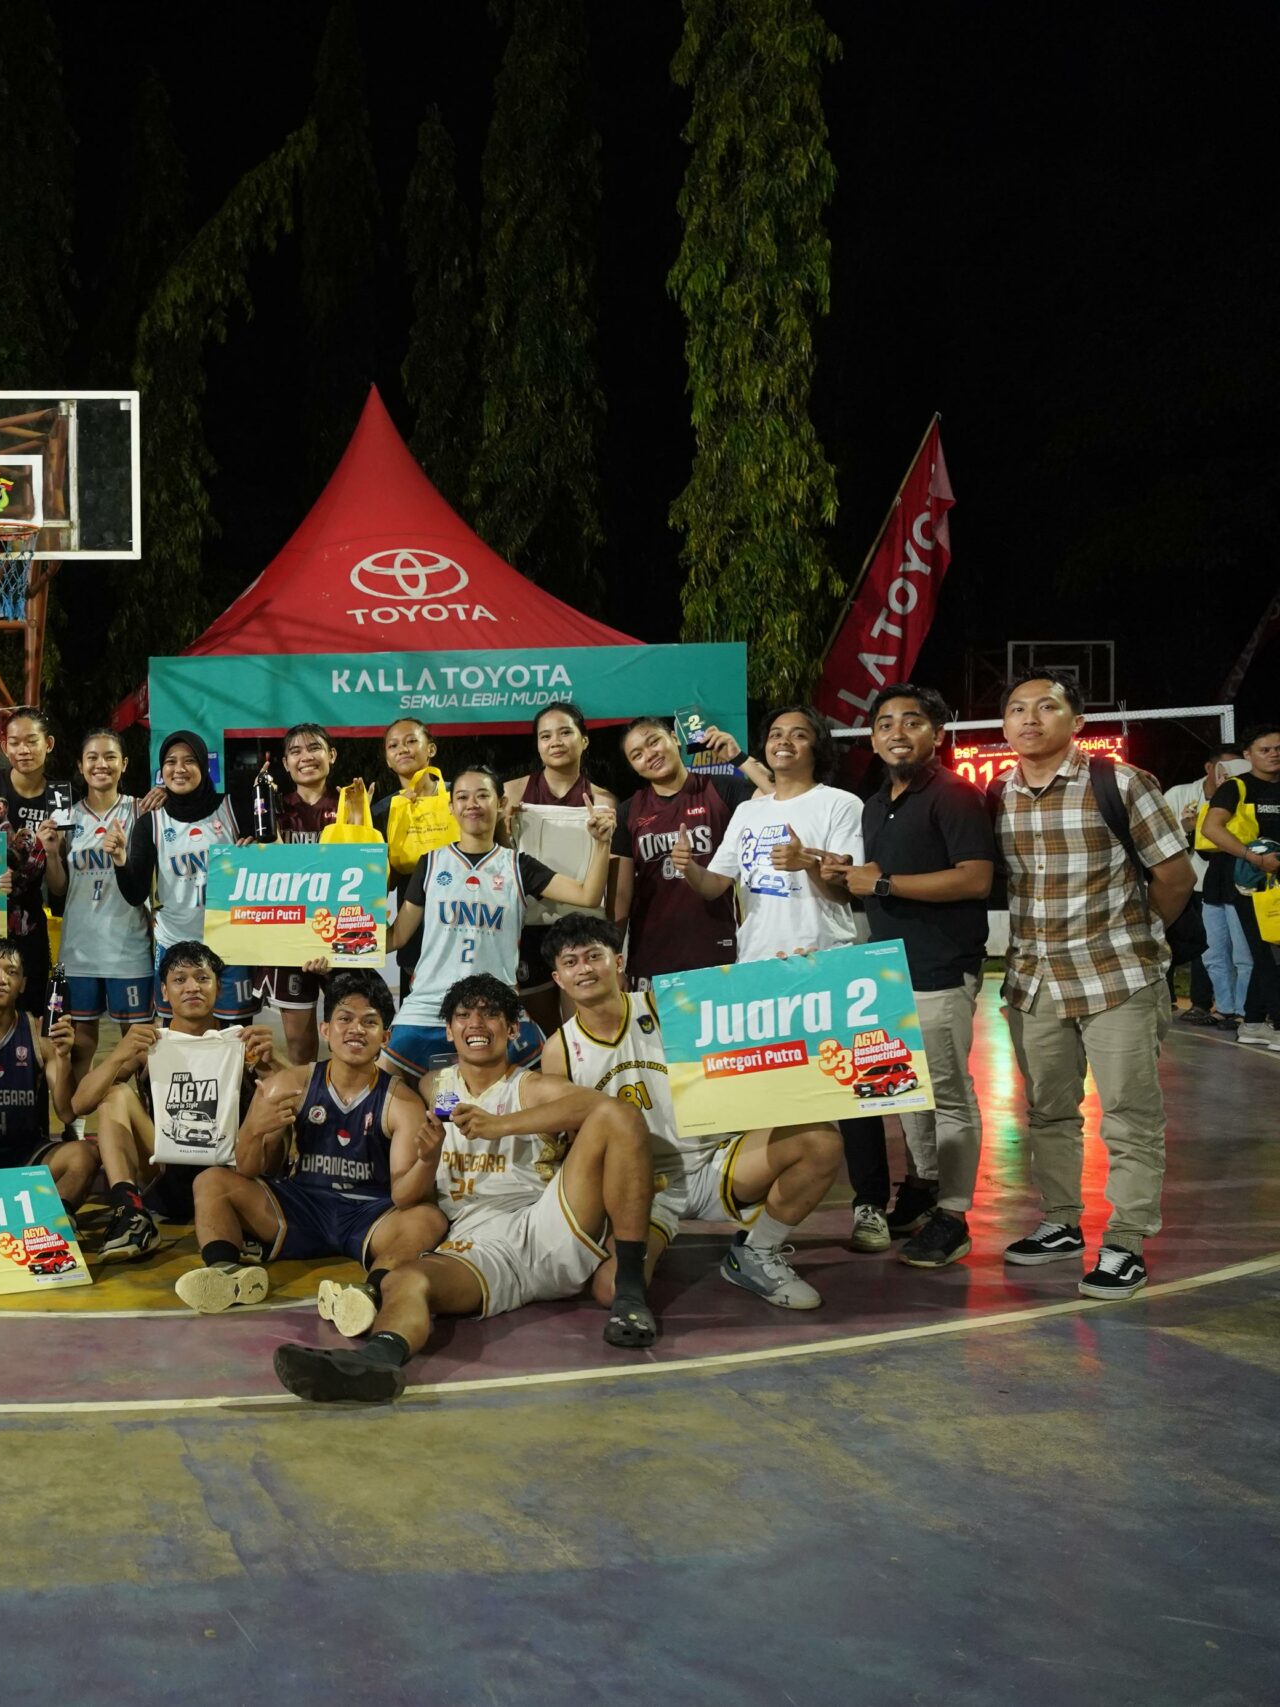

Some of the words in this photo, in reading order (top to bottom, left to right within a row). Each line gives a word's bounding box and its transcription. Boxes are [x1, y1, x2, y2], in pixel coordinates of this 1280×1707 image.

[346, 604, 498, 625] TOYOTA
[331, 667, 437, 693] KALLA
[440, 664, 573, 690] TOYOTA
[400, 694, 459, 710] SEMUA
[461, 692, 509, 708] LEBIH
[510, 690, 573, 706] MUDAH
[169, 850, 209, 877] UN
[229, 867, 331, 902] Juara
[337, 867, 364, 902] 2
[277, 908, 301, 920] Putri
[438, 901, 505, 930] UNM
[461, 938, 475, 963] 2
[127, 986, 139, 1007] 8
[695, 990, 832, 1048] Juara
[846, 978, 879, 1028] 2
[764, 1048, 803, 1065] Putra
[173, 1073, 190, 1082] NEW
[168, 1080, 217, 1103] AGYA
[301, 1153, 375, 1181] DIPANEGAR
[442, 1151, 506, 1172] PANEGARA
[14, 1190, 35, 1224] 1
